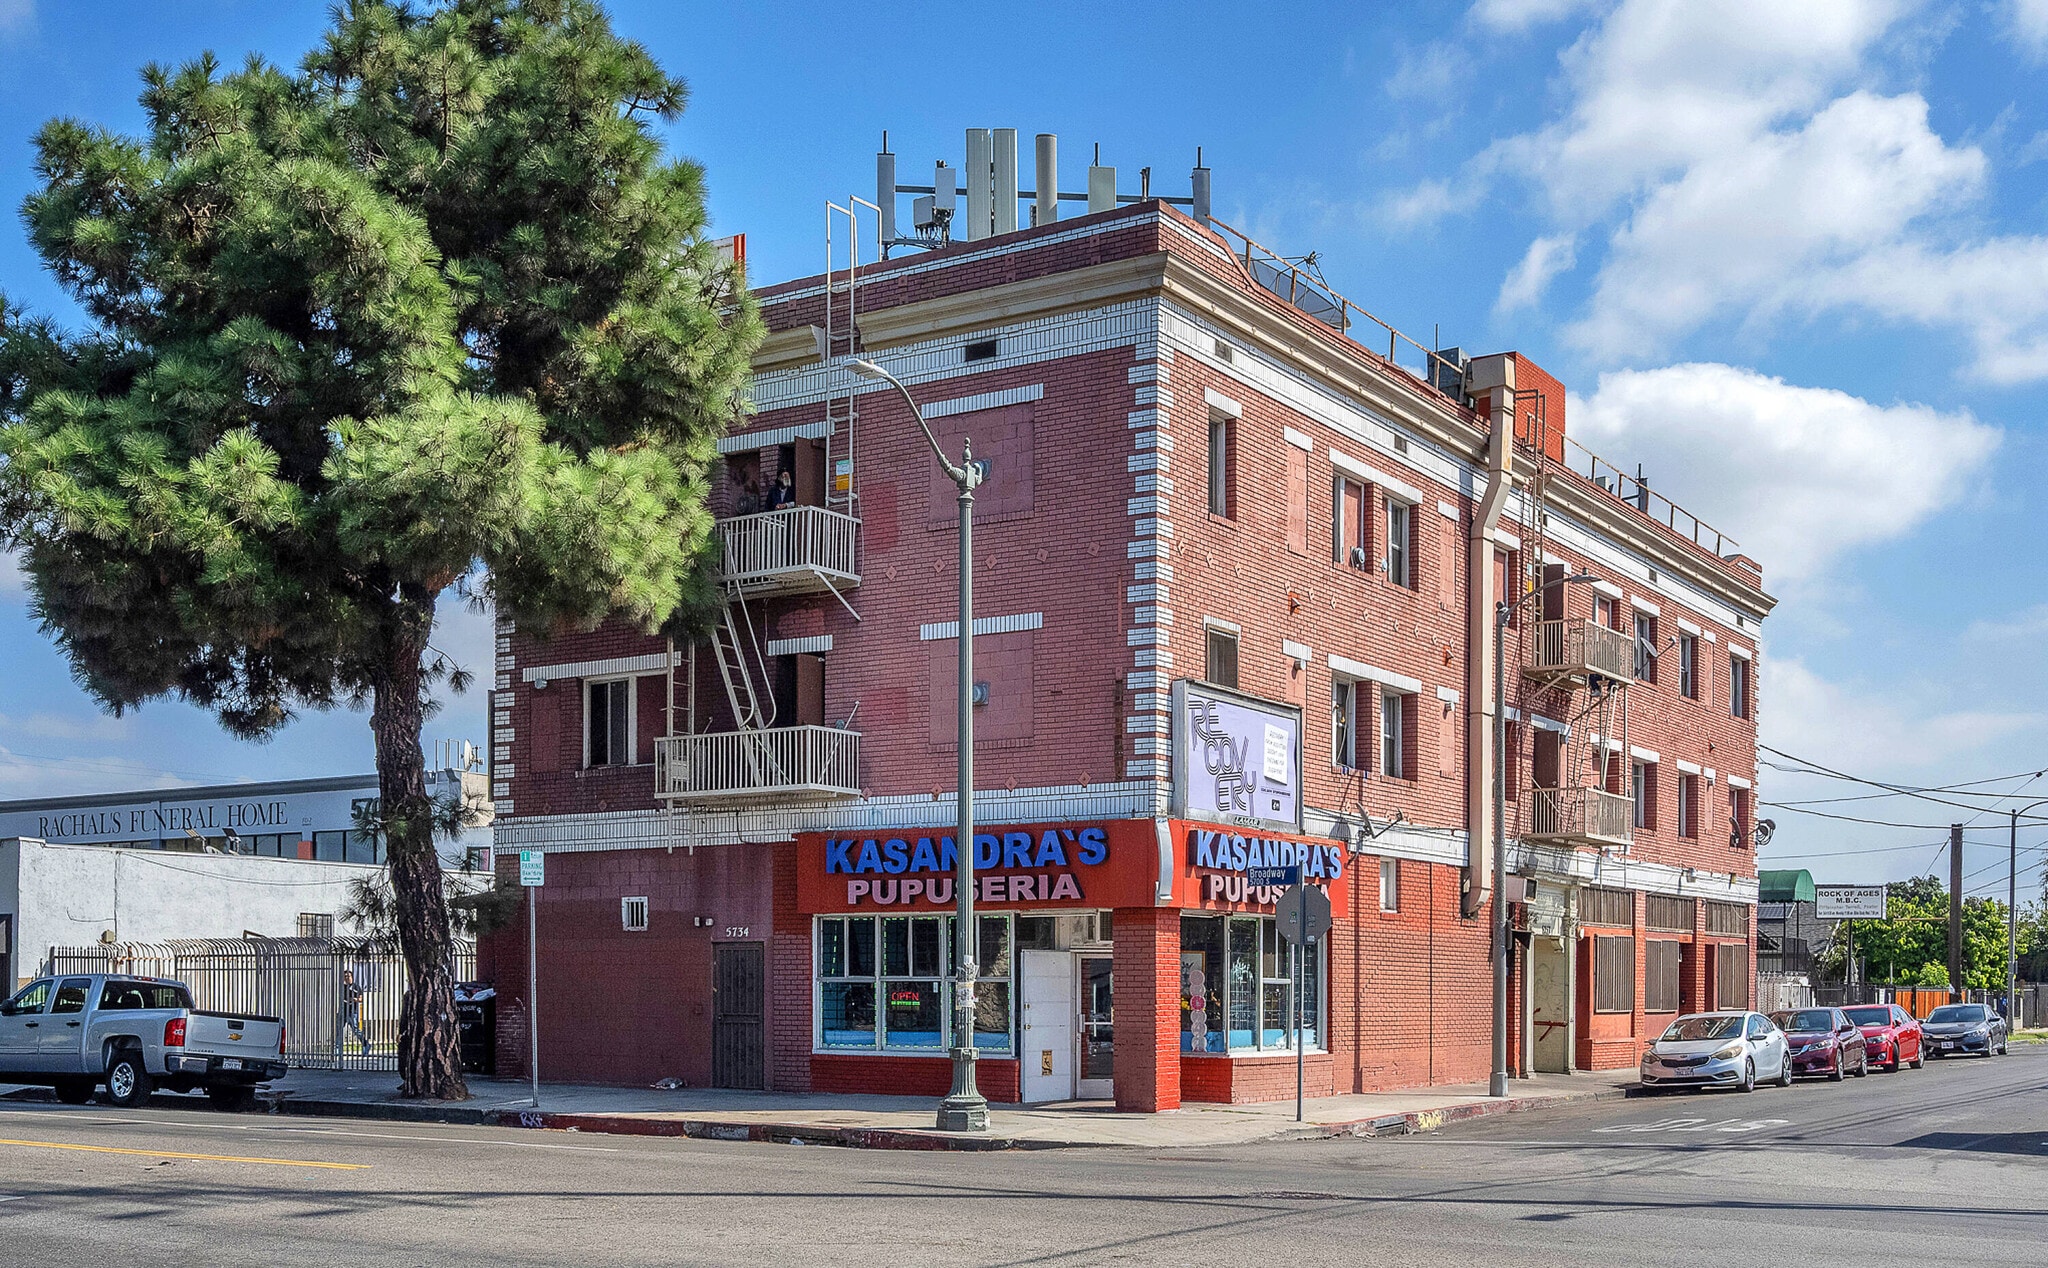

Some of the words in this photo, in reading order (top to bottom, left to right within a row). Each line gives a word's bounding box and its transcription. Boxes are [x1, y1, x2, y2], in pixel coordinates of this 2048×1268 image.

[38, 811, 121, 838] RACHAL'S
[130, 805, 220, 833] FUNERAL
[227, 801, 288, 827] HOME
[1249, 868, 1286, 880] Broadway
[725, 926, 749, 938] 5734
